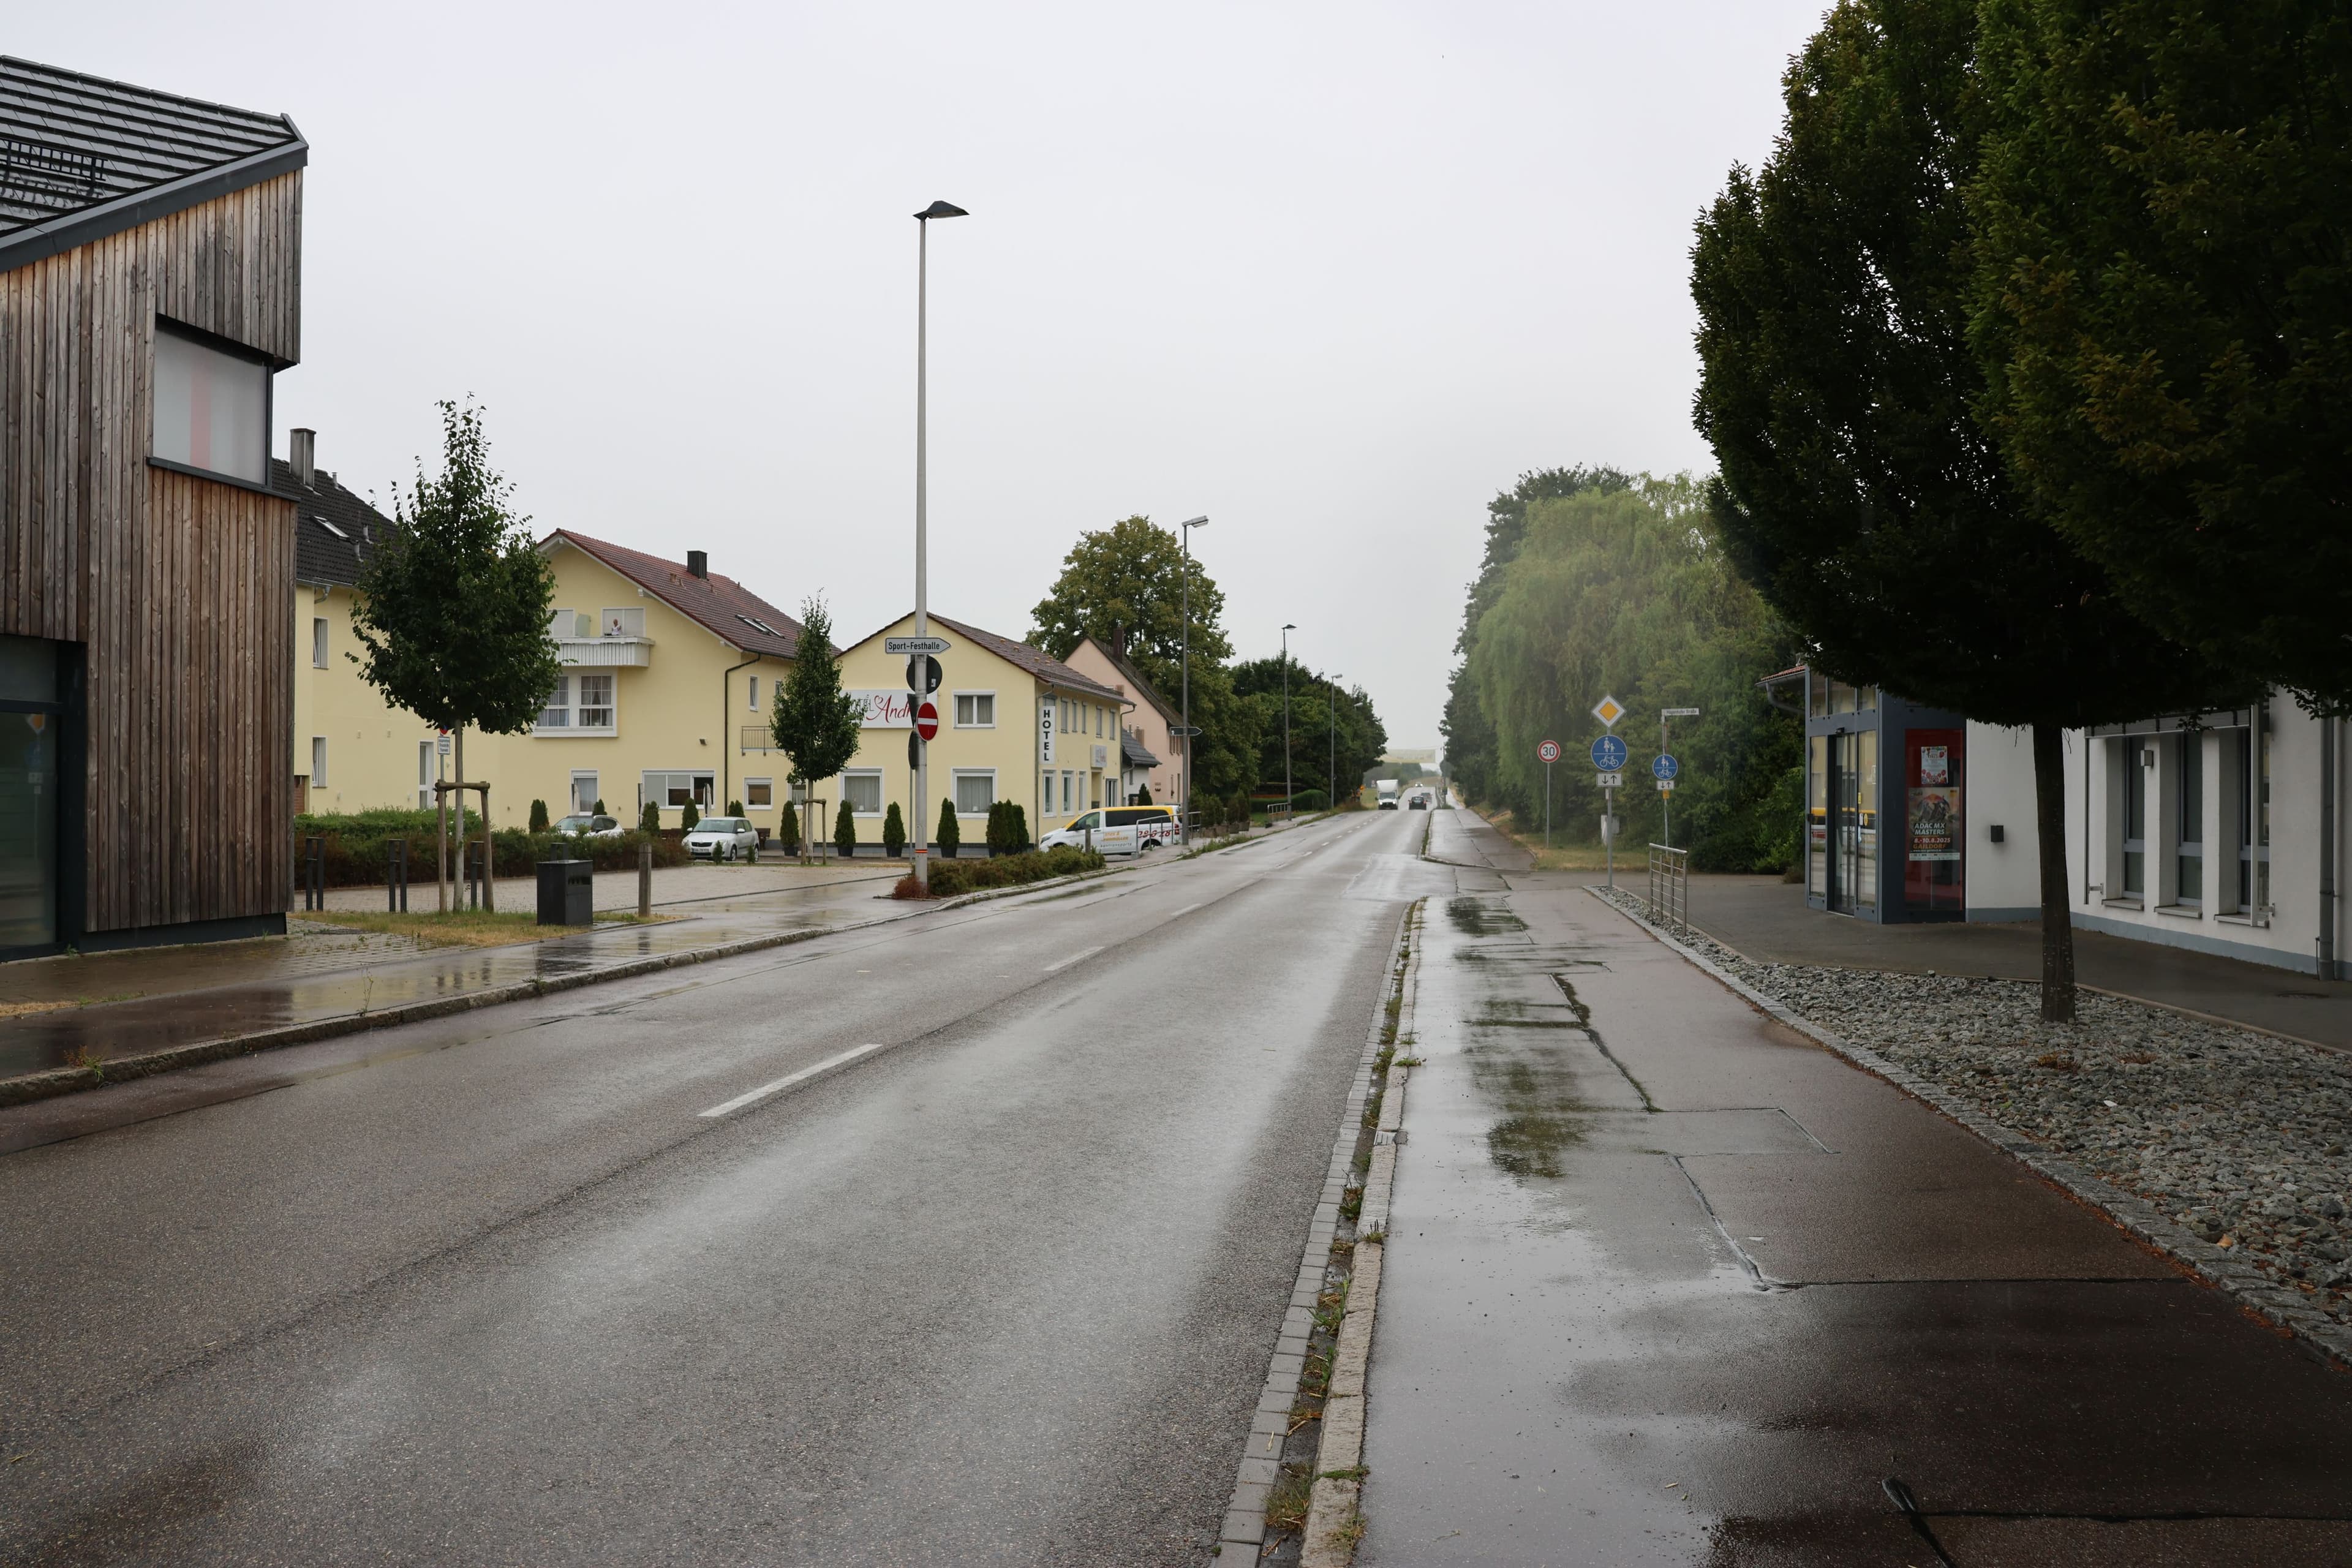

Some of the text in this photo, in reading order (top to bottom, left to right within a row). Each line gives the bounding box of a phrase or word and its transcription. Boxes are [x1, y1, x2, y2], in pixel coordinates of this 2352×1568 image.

[888, 641, 940, 651] Sport-Festhalle
[1042, 710, 1051, 761] HOTEL
[1543, 746, 1555, 756] 30
